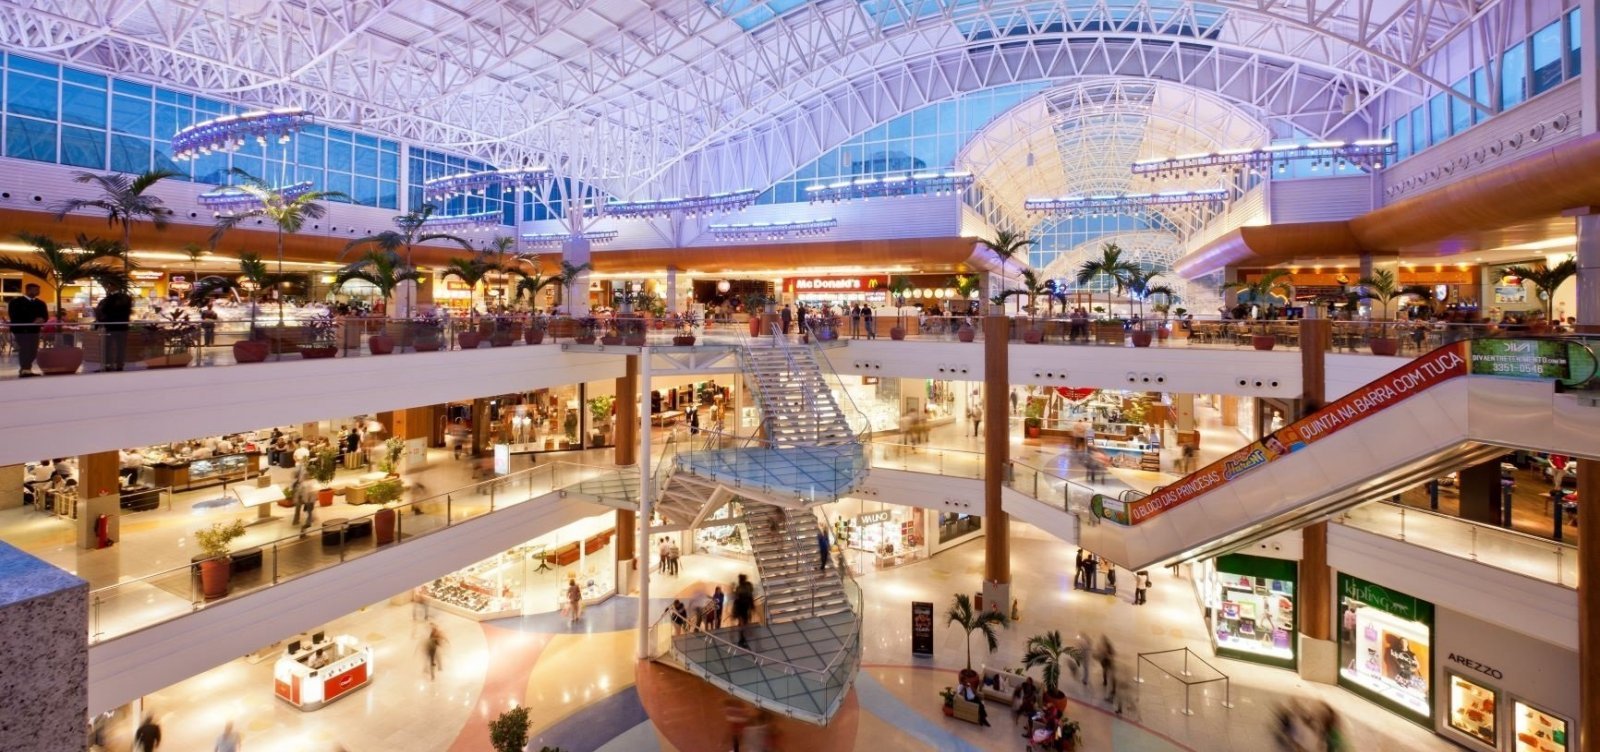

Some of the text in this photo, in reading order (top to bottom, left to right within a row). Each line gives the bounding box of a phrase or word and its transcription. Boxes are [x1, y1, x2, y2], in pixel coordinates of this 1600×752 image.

[1300, 351, 1465, 440] QUINTA NA BARRA COM TUCA
[1132, 508, 1140, 520] O
[1139, 500, 1163, 517] BLOCO
[1162, 490, 1177, 506] DAS
[1176, 471, 1220, 498] PRINCESAS
[1448, 652, 1504, 680] AREZZO
